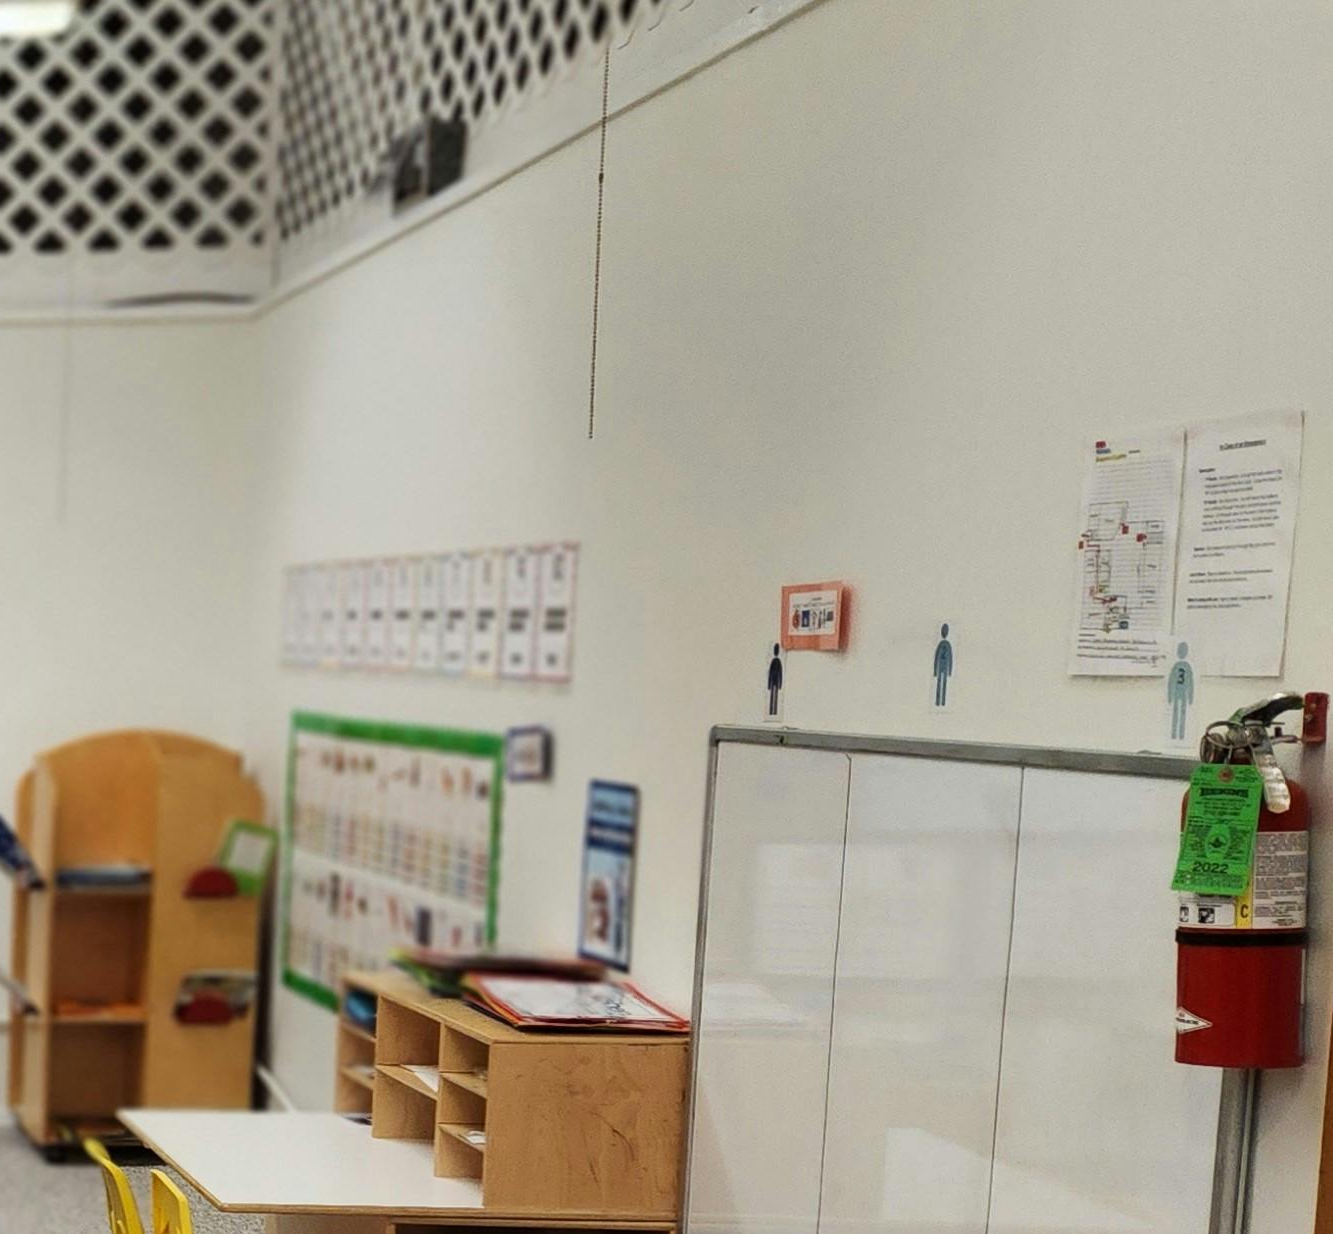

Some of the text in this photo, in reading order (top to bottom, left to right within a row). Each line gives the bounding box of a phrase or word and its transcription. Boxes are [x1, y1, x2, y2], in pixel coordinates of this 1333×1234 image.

[1177, 668, 1186, 685] 3
[1192, 861, 1230, 875] 2022
[1240, 904, 1249, 919] C
